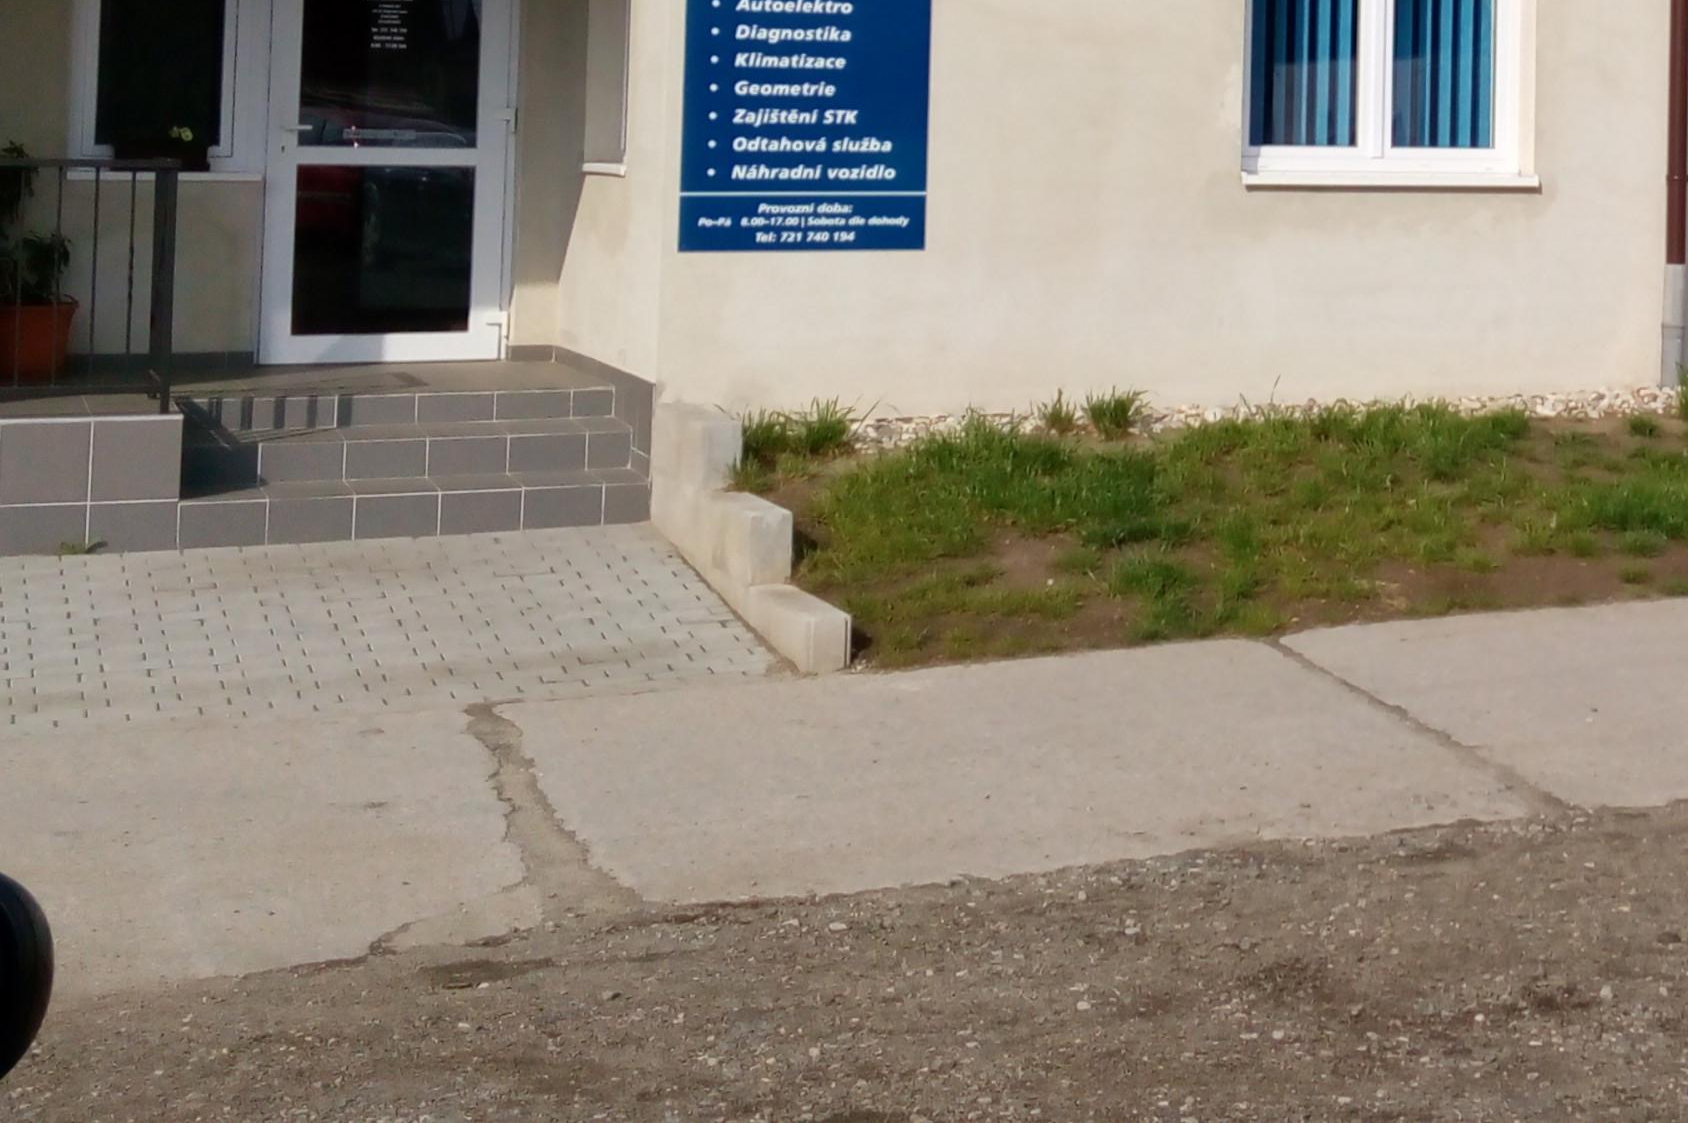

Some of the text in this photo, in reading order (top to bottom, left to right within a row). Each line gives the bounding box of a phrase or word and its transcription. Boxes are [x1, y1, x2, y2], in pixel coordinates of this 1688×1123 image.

[734, 24, 853, 44] Diagnostika
[734, 52, 847, 70] Klimatizace
[734, 80, 837, 97] Geometrie
[732, 108, 858, 127] Zajištění STK
[732, 136, 893, 153] Odtahová služba
[731, 164, 897, 180] Náhradní vozidlo
[757, 203, 853, 215] Provozní doba:
[806, 216, 846, 227] Sobota
[867, 215, 910, 227] dohody
[779, 231, 803, 243] 721
[805, 231, 830, 243] 740
[832, 231, 856, 242] 194
